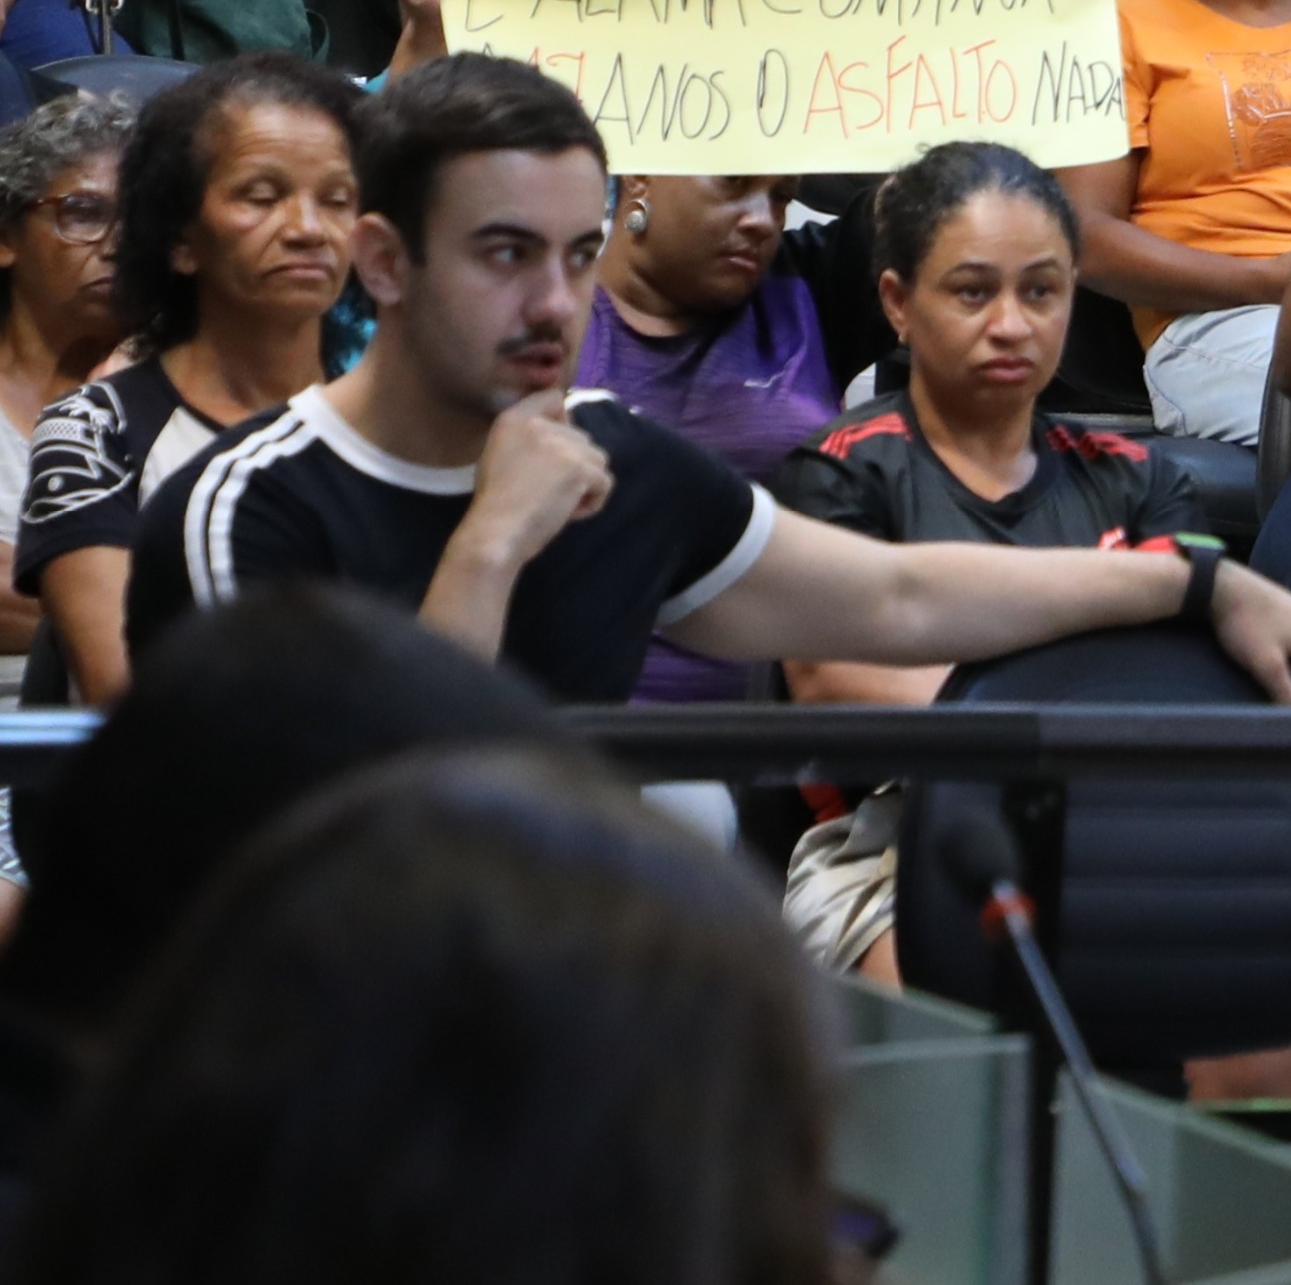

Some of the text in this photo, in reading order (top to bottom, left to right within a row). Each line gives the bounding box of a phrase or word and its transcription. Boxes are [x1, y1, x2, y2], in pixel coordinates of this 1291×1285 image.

[592, 51, 732, 146] ANOS
[803, 35, 1018, 140] ASFALTO
[1031, 40, 1127, 127] NADA
